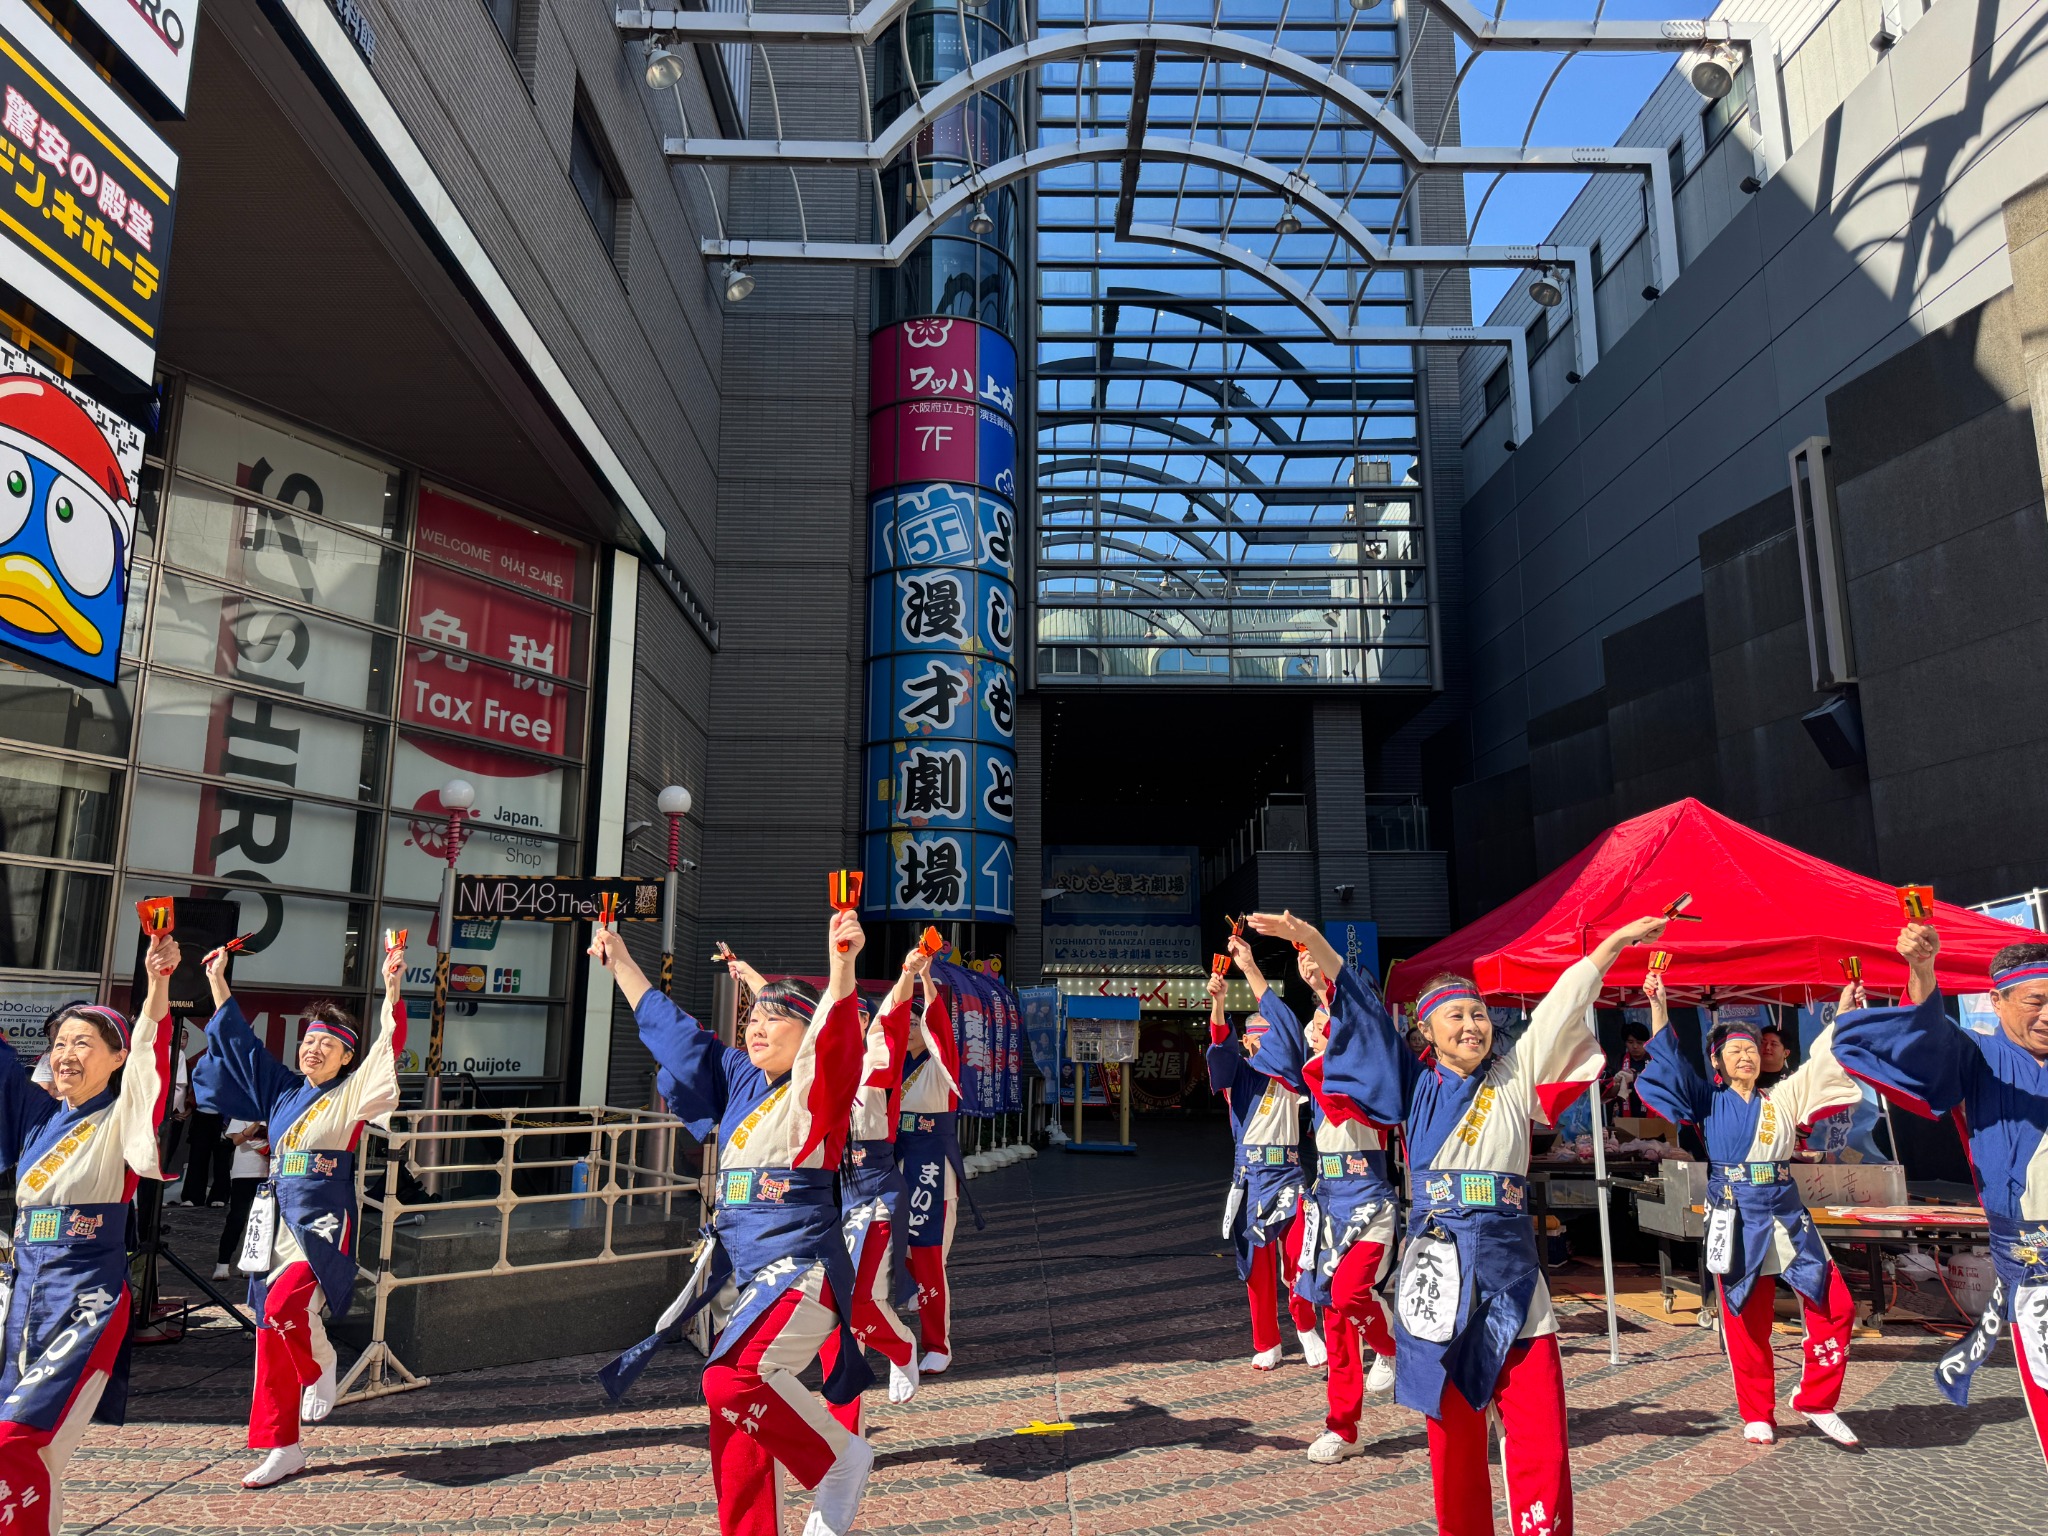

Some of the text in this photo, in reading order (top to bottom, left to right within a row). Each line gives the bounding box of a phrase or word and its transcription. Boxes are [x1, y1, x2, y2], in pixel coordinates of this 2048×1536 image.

[3, 86, 153, 250] 驚安の殿堂
[915, 426, 953, 451] 7F
[420, 527, 491, 563] WELCOME
[905, 513, 964, 562] 5F
[500, 555, 526, 577] 어서
[418, 607, 555, 697] 免税
[414, 679, 552, 743] Tax Free
[899, 578, 965, 908] 漫才劇場
[493, 805, 543, 828] Japan.
[505, 848, 542, 868] Shop
[1057, 875, 1185, 894] よしもと漫才劇場
[459, 882, 556, 914] NMB48
[1049, 938, 1106, 946] YOSHIMOTO
[1109, 938, 1146, 946] MANZAI
[493, 976, 520, 985] JCB
[1178, 998, 1212, 1009] ヨシモ
[9, 1023, 47, 1038] cloa
[463, 1057, 521, 1076] Quijote
[1806, 1167, 1871, 1202] 注意
[1411, 1250, 1443, 1323] 大福帳
